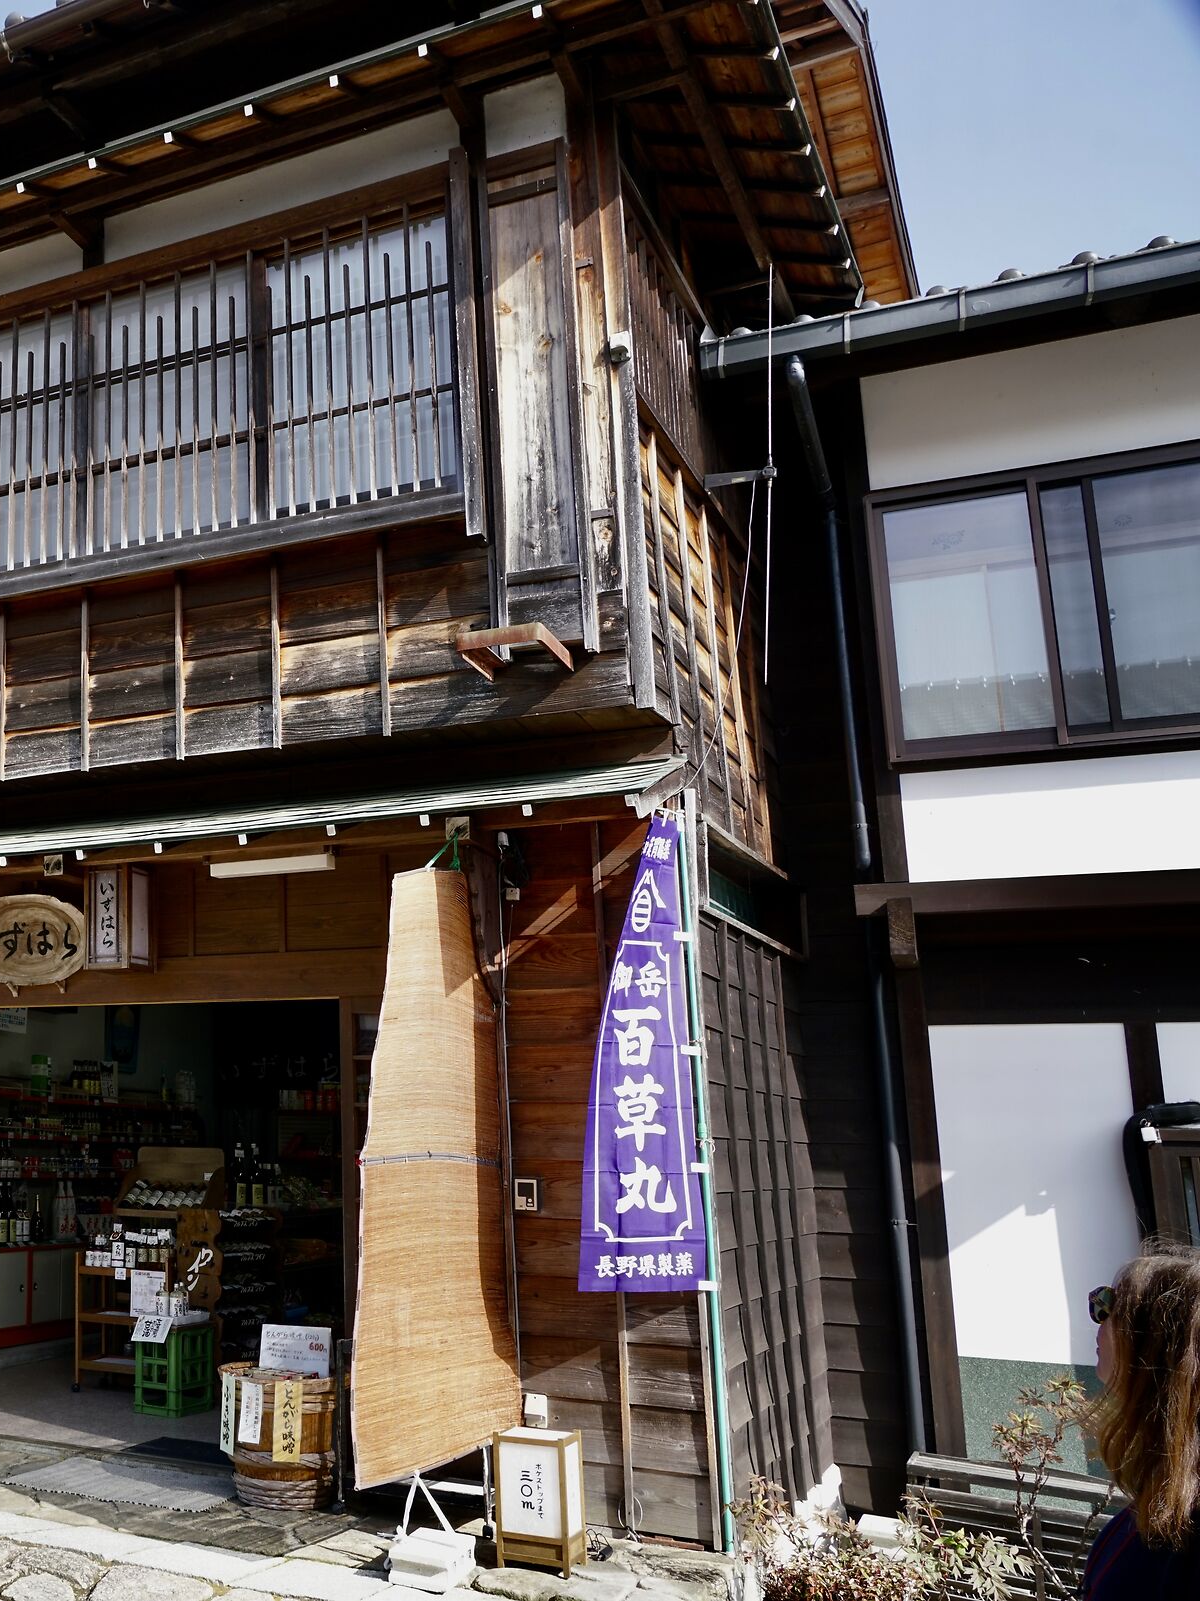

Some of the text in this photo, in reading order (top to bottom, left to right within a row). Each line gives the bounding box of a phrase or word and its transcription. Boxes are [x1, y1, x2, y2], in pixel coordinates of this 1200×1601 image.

[99, 882, 116, 949] いずはら
[612, 960, 667, 998] 御岳
[611, 1005, 678, 1214] 百草丸
[594, 1251, 694, 1279] 長野県製薬
